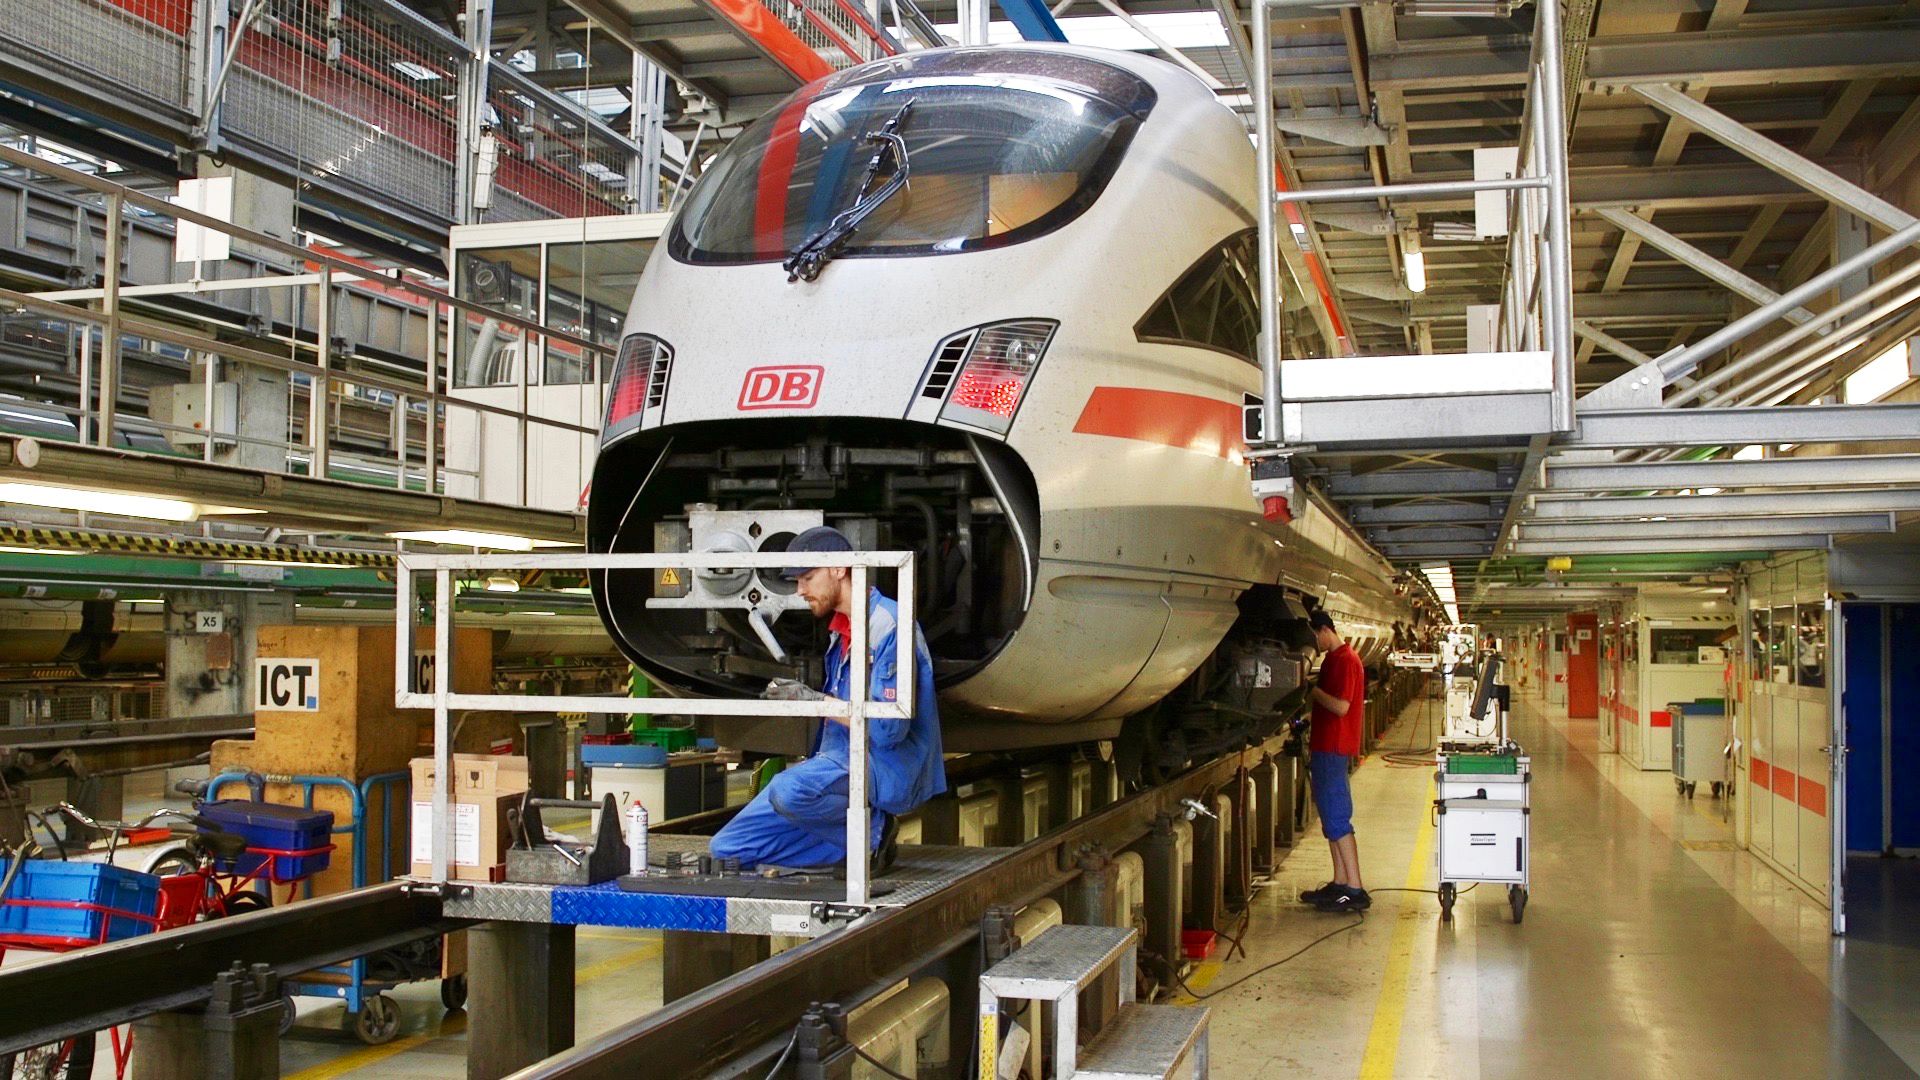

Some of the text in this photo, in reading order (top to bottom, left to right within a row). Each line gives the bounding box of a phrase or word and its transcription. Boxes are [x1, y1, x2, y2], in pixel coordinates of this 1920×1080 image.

[748, 372, 812, 402] DB
[202, 616, 217, 628] X5
[622, 791, 631, 805] 7
